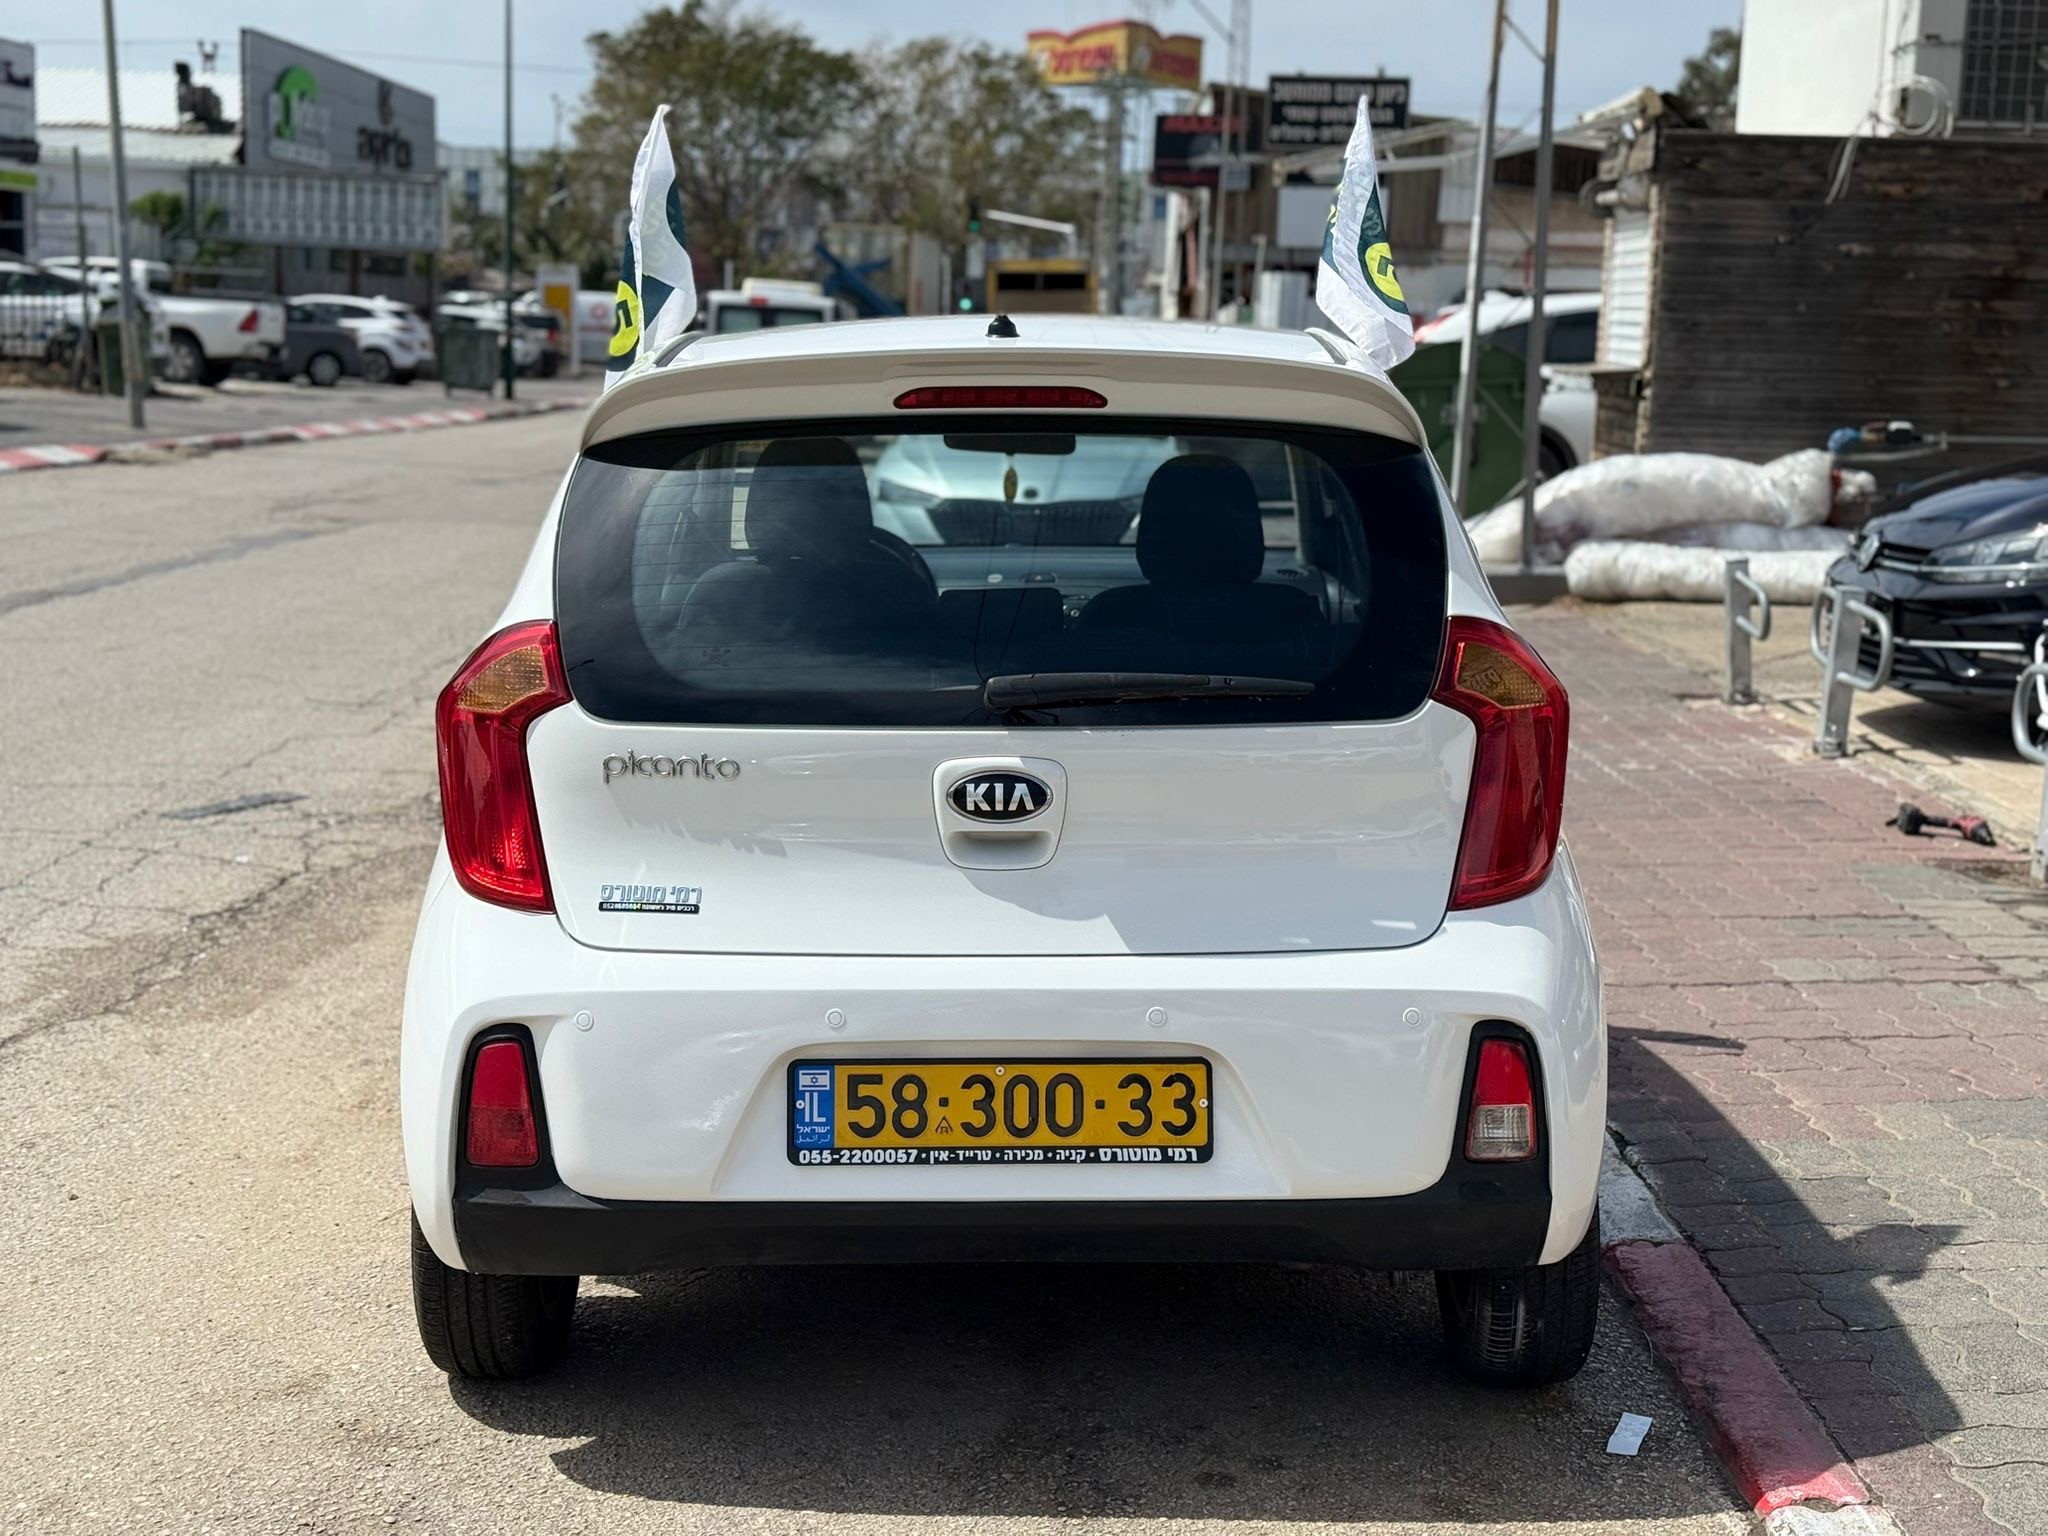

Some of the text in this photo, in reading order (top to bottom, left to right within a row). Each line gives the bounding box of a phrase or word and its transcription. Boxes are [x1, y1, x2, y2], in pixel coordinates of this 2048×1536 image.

[602, 749, 741, 784] picanto
[965, 783, 1035, 811] KIA
[600, 885, 702, 904] רמי מוטורס
[804, 1092, 827, 1122] IL
[796, 1124, 831, 1134] ישראל
[799, 1148, 1198, 1164] רמי מוטורס קניה מכירה טרייד-אין 055-2200057
